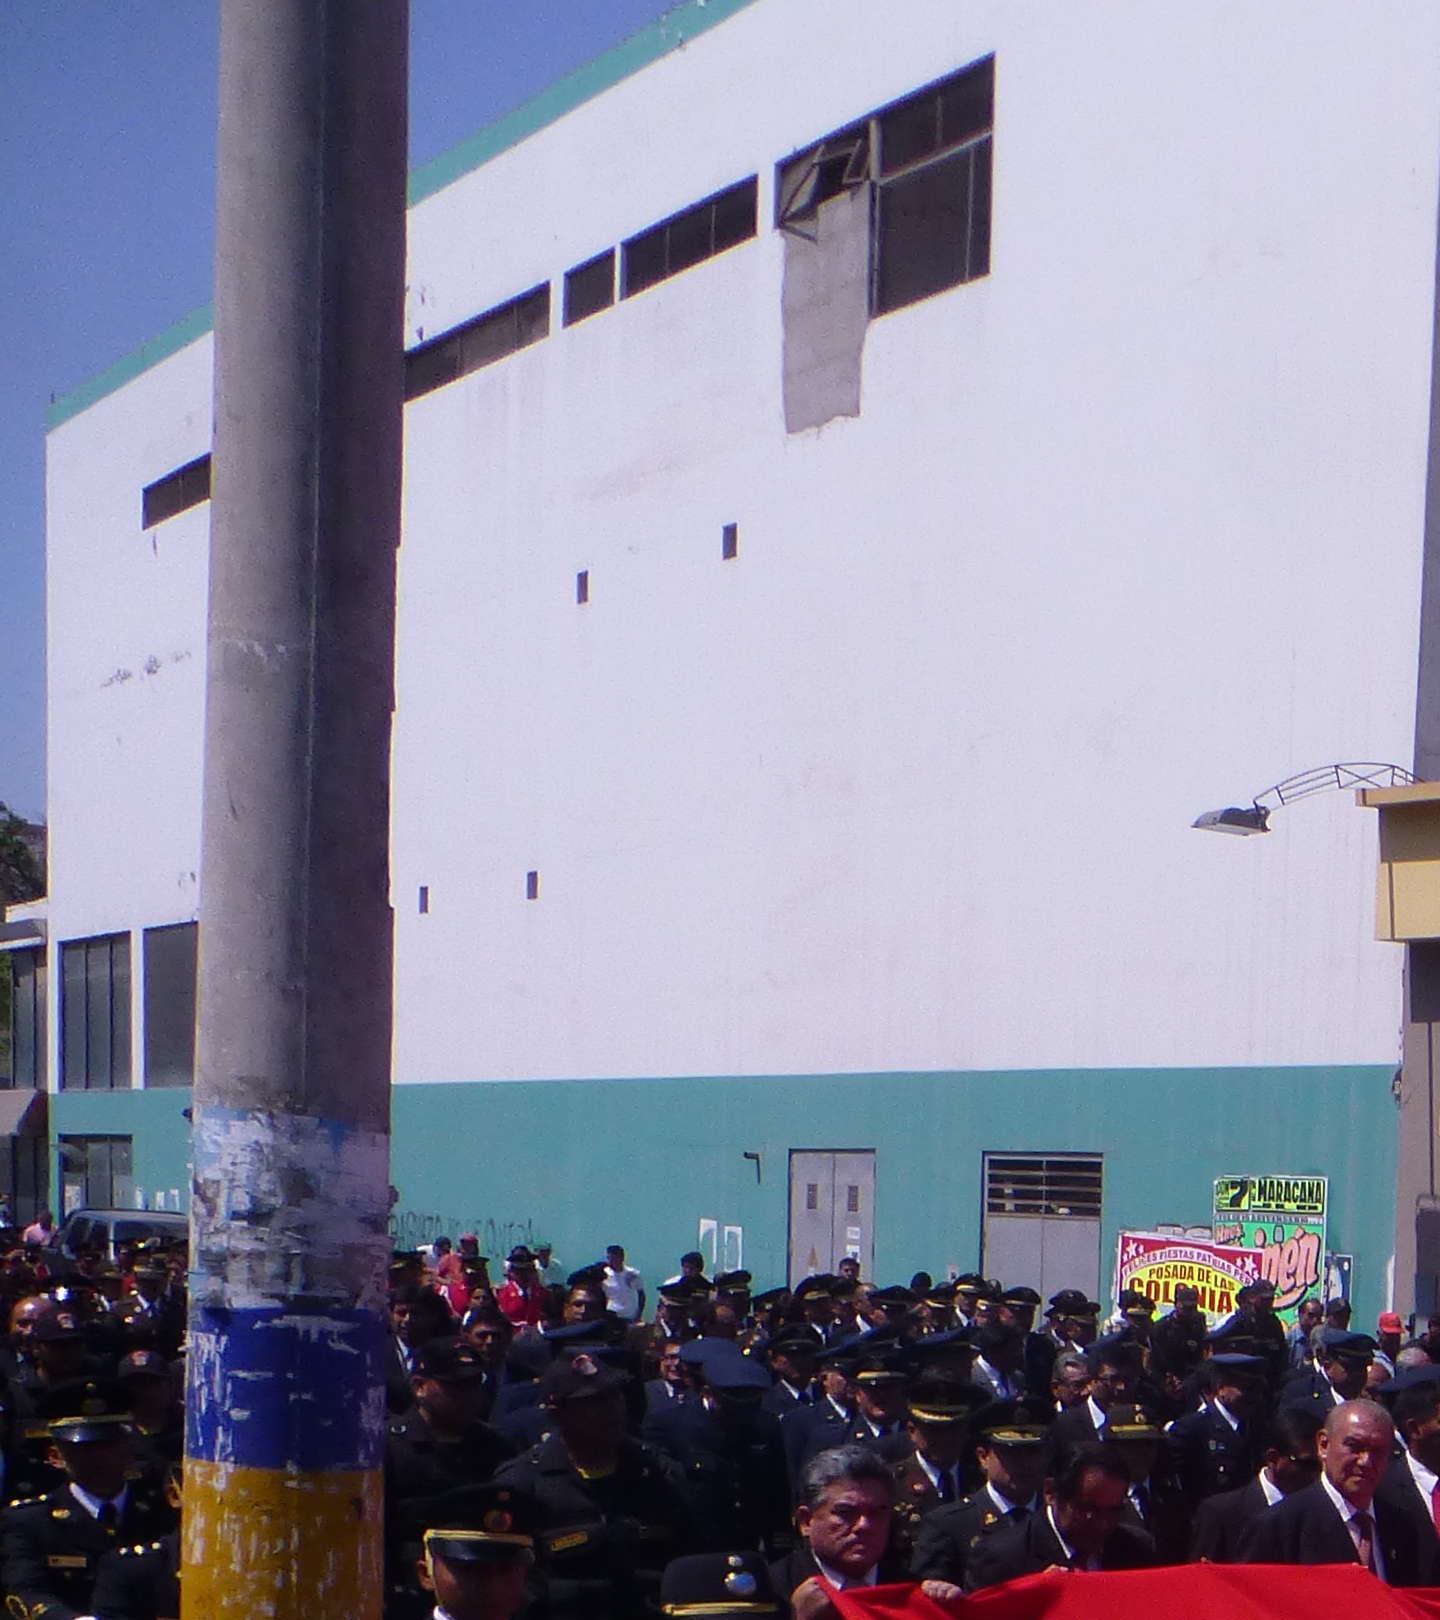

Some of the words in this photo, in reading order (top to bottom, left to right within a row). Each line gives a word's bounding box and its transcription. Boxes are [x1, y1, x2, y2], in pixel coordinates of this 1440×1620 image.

[1229, 1178, 1249, 1208] 7
[1257, 1178, 1323, 1204] MARACANA
[1160, 1249, 1194, 1260] FIESTAS
[1149, 1264, 1194, 1281] POSADA
[1197, 1267, 1212, 1284] DE
[1214, 1275, 1236, 1291] LAS
